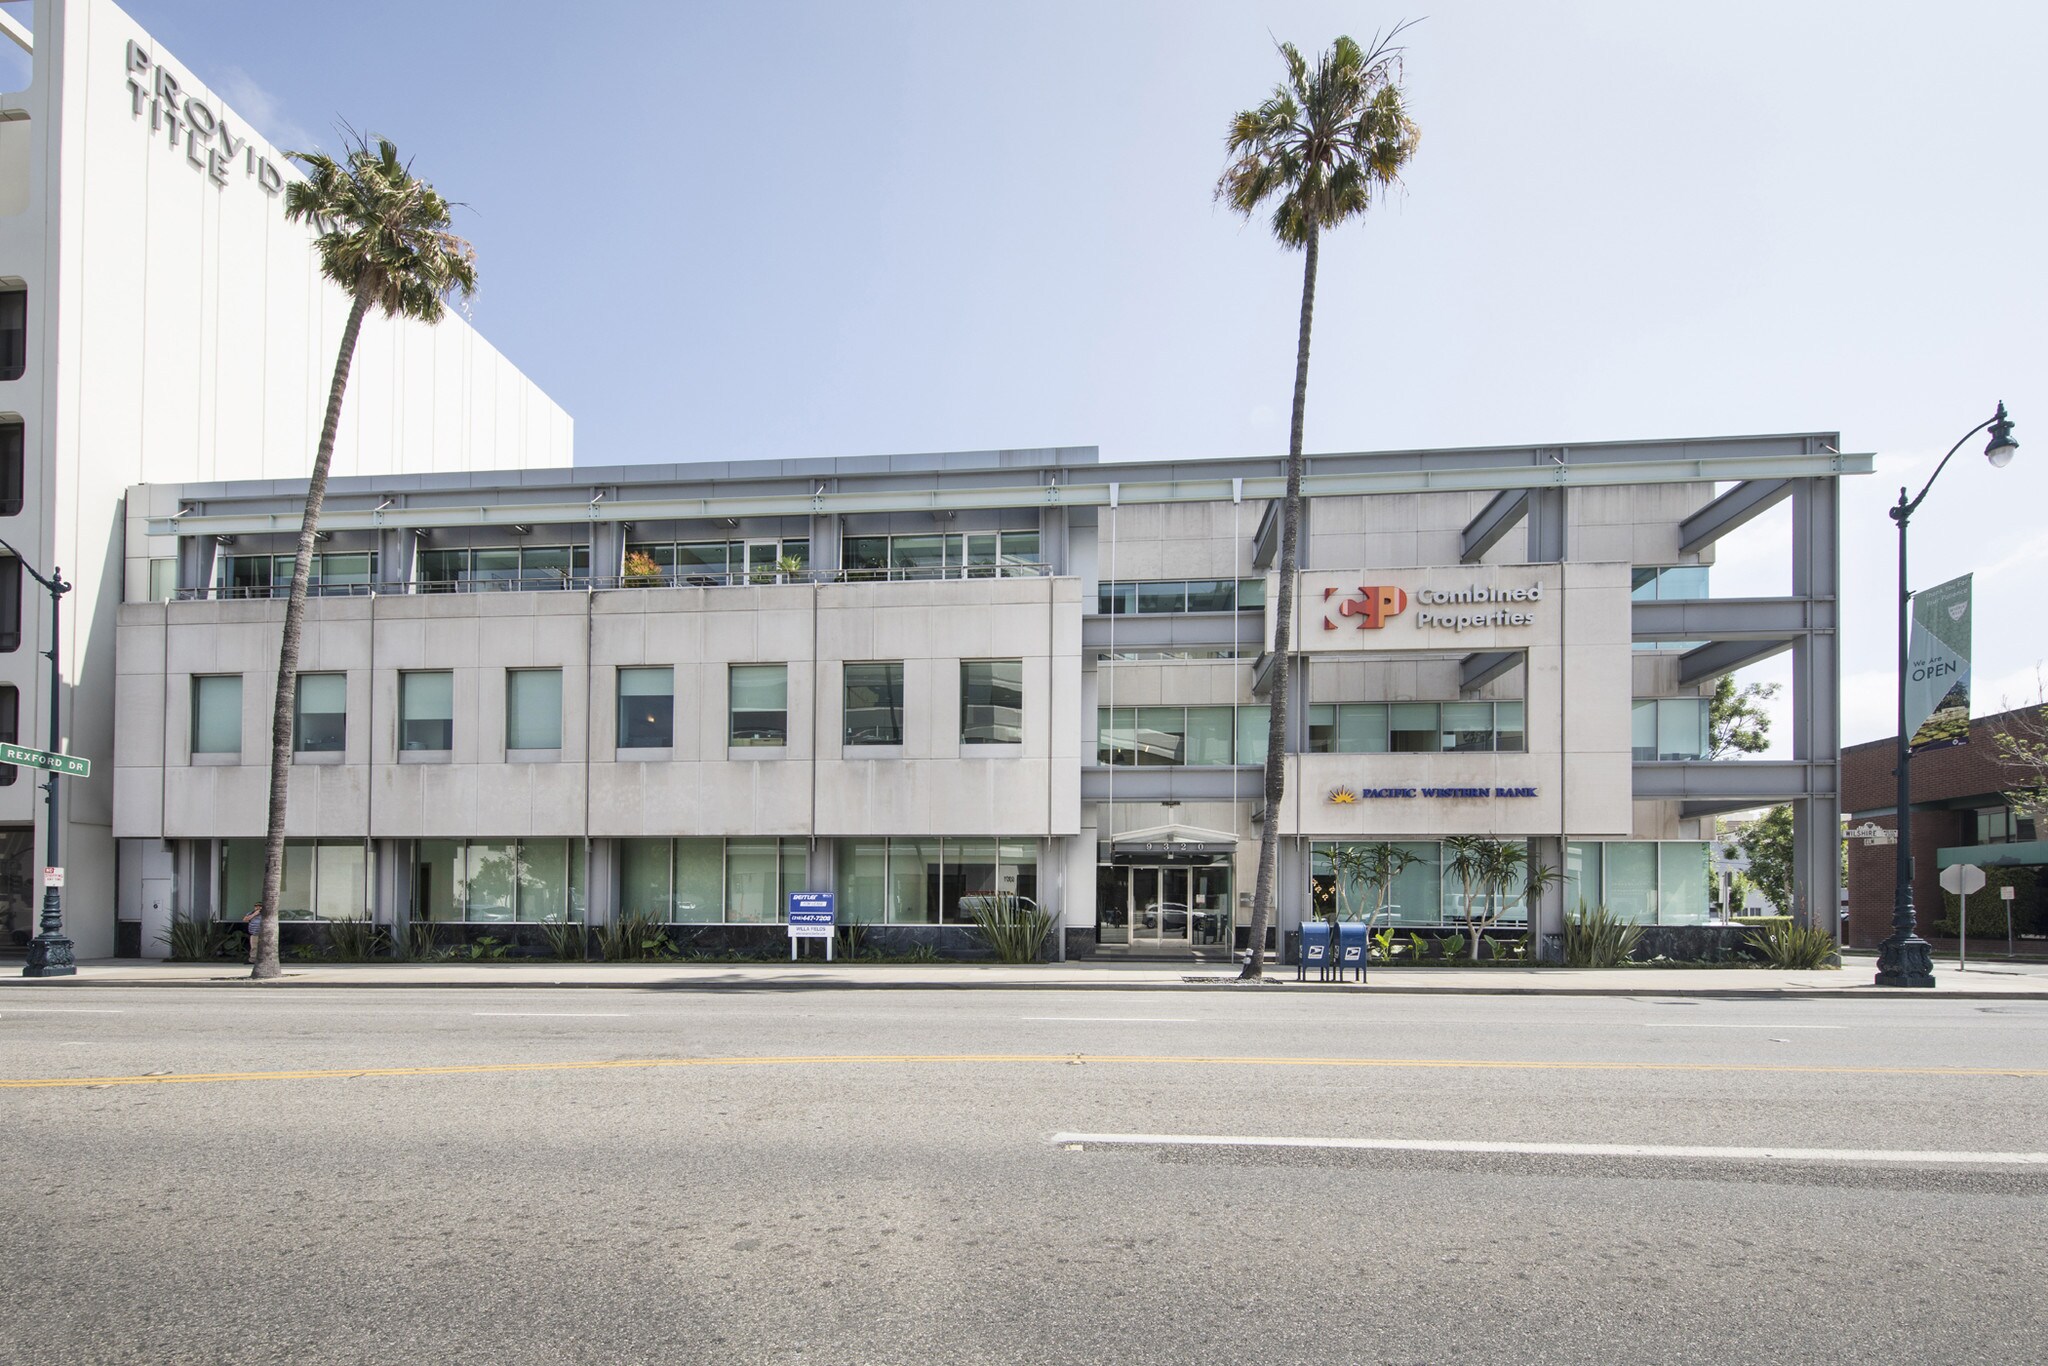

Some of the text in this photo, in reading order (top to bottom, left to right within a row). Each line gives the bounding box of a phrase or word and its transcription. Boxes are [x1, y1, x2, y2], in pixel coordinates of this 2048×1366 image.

[126, 76, 230, 188] TITLE
[1416, 581, 1543, 605] Combined
[1416, 608, 1535, 633] Properties
[1912, 660, 1957, 682] OPEN
[1913, 656, 1942, 668] We Are
[7, 749, 83, 771] REXFORD DR
[1362, 787, 1538, 799] PACIFIC WESTERN BANK
